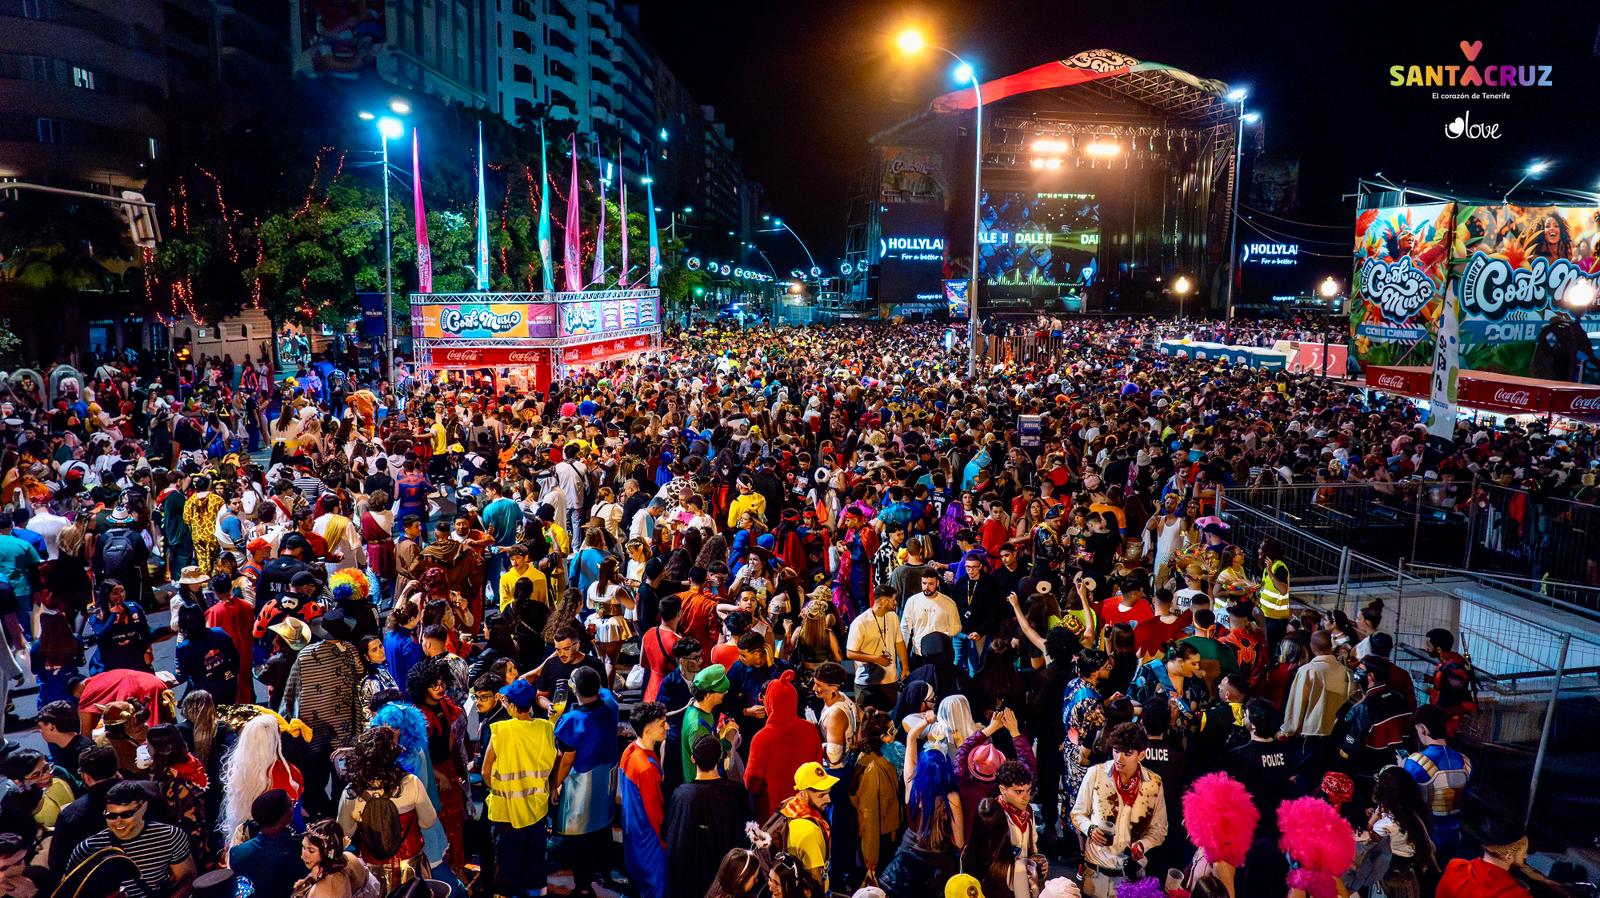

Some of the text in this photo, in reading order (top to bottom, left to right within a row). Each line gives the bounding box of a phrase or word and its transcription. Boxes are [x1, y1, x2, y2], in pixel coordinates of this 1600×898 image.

[978, 232, 998, 244] ALE
[1015, 233, 1044, 244] DALE
[920, 253, 939, 261] better
[1465, 261, 1482, 302] TENERIFE
[1476, 260, 1547, 312] Cook
[1485, 323, 1536, 340] CON EL
[1145, 747, 1169, 762] OLICE
[1261, 752, 1285, 768] POLICE
